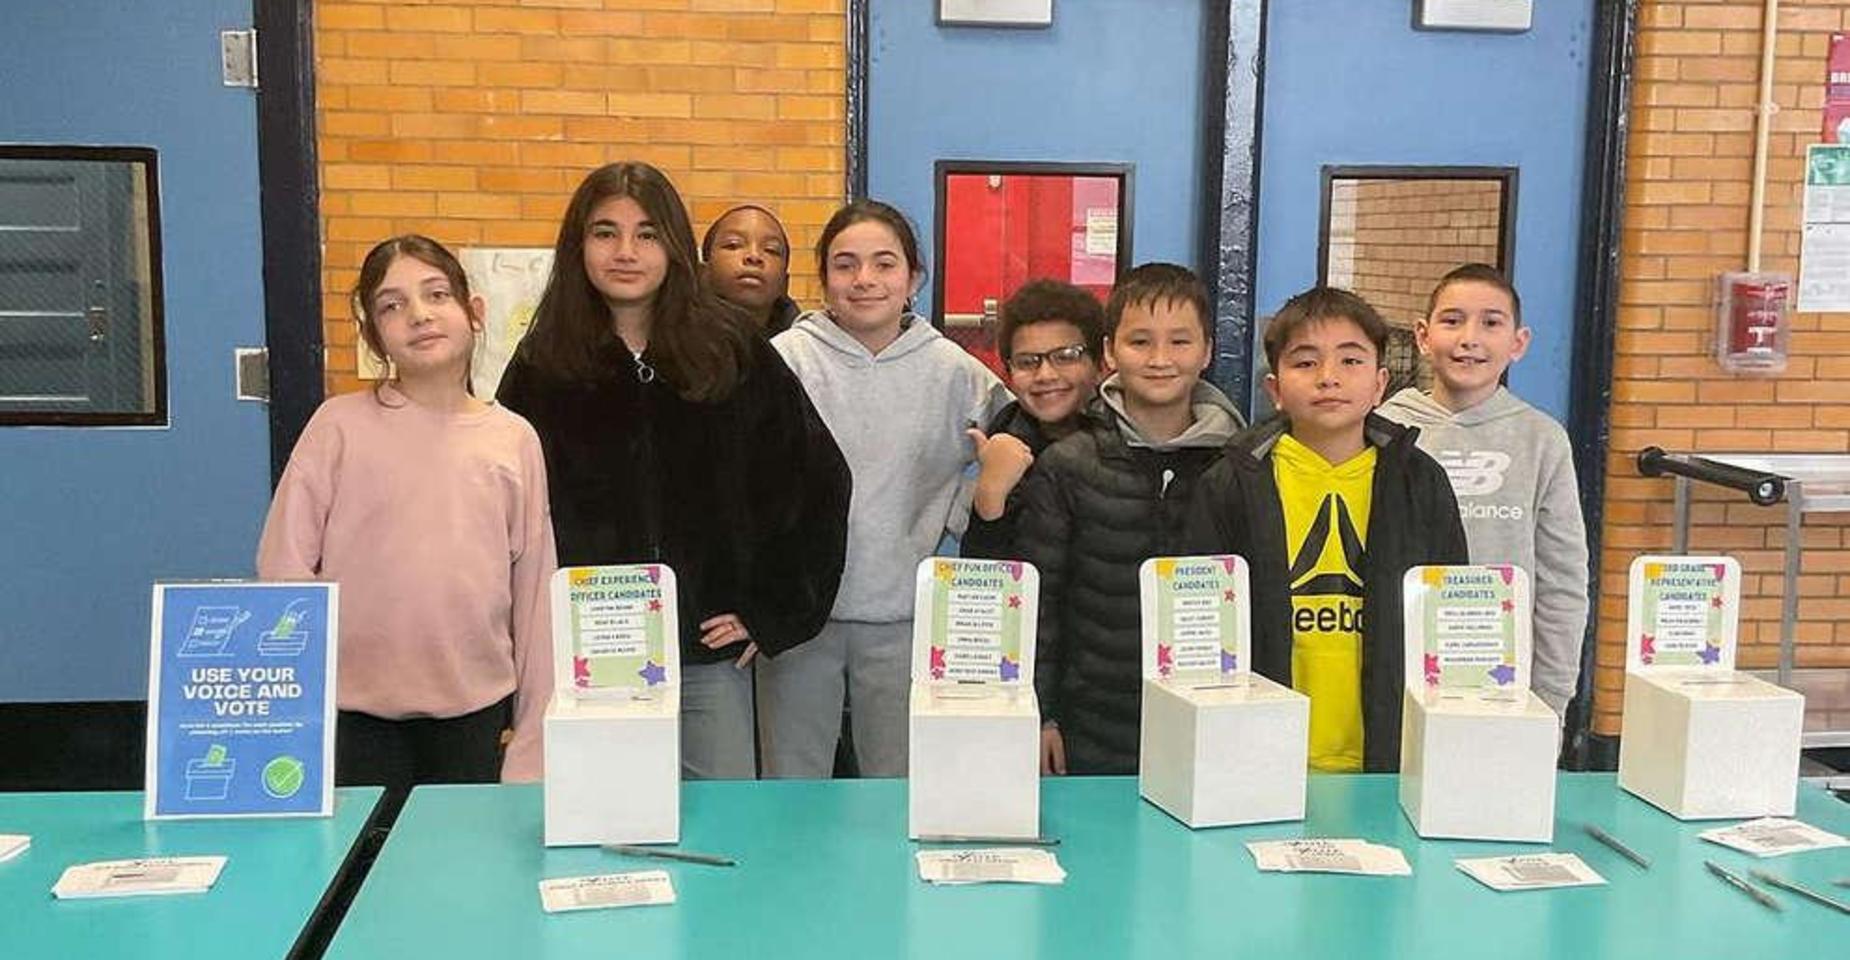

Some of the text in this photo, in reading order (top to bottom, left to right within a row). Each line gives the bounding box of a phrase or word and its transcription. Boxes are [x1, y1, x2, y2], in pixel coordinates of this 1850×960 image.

[1459, 503, 1523, 519] alance
[1175, 566, 1216, 576] PRESIDENT
[952, 578, 1004, 588] CANDIDATES
[1443, 575, 1493, 584] TREASURER
[1172, 580, 1220, 591] CANDIDATES
[570, 589, 662, 601] OFFICER CANDIDATES
[1441, 590, 1495, 599] CANDIDATES
[1660, 592, 1707, 601] CANDIDATES
[1295, 601, 1363, 632] eebo
[191, 667, 295, 683] USE YOUR
[183, 683, 303, 700] VOICE AND
[214, 700, 270, 716] VOTE
